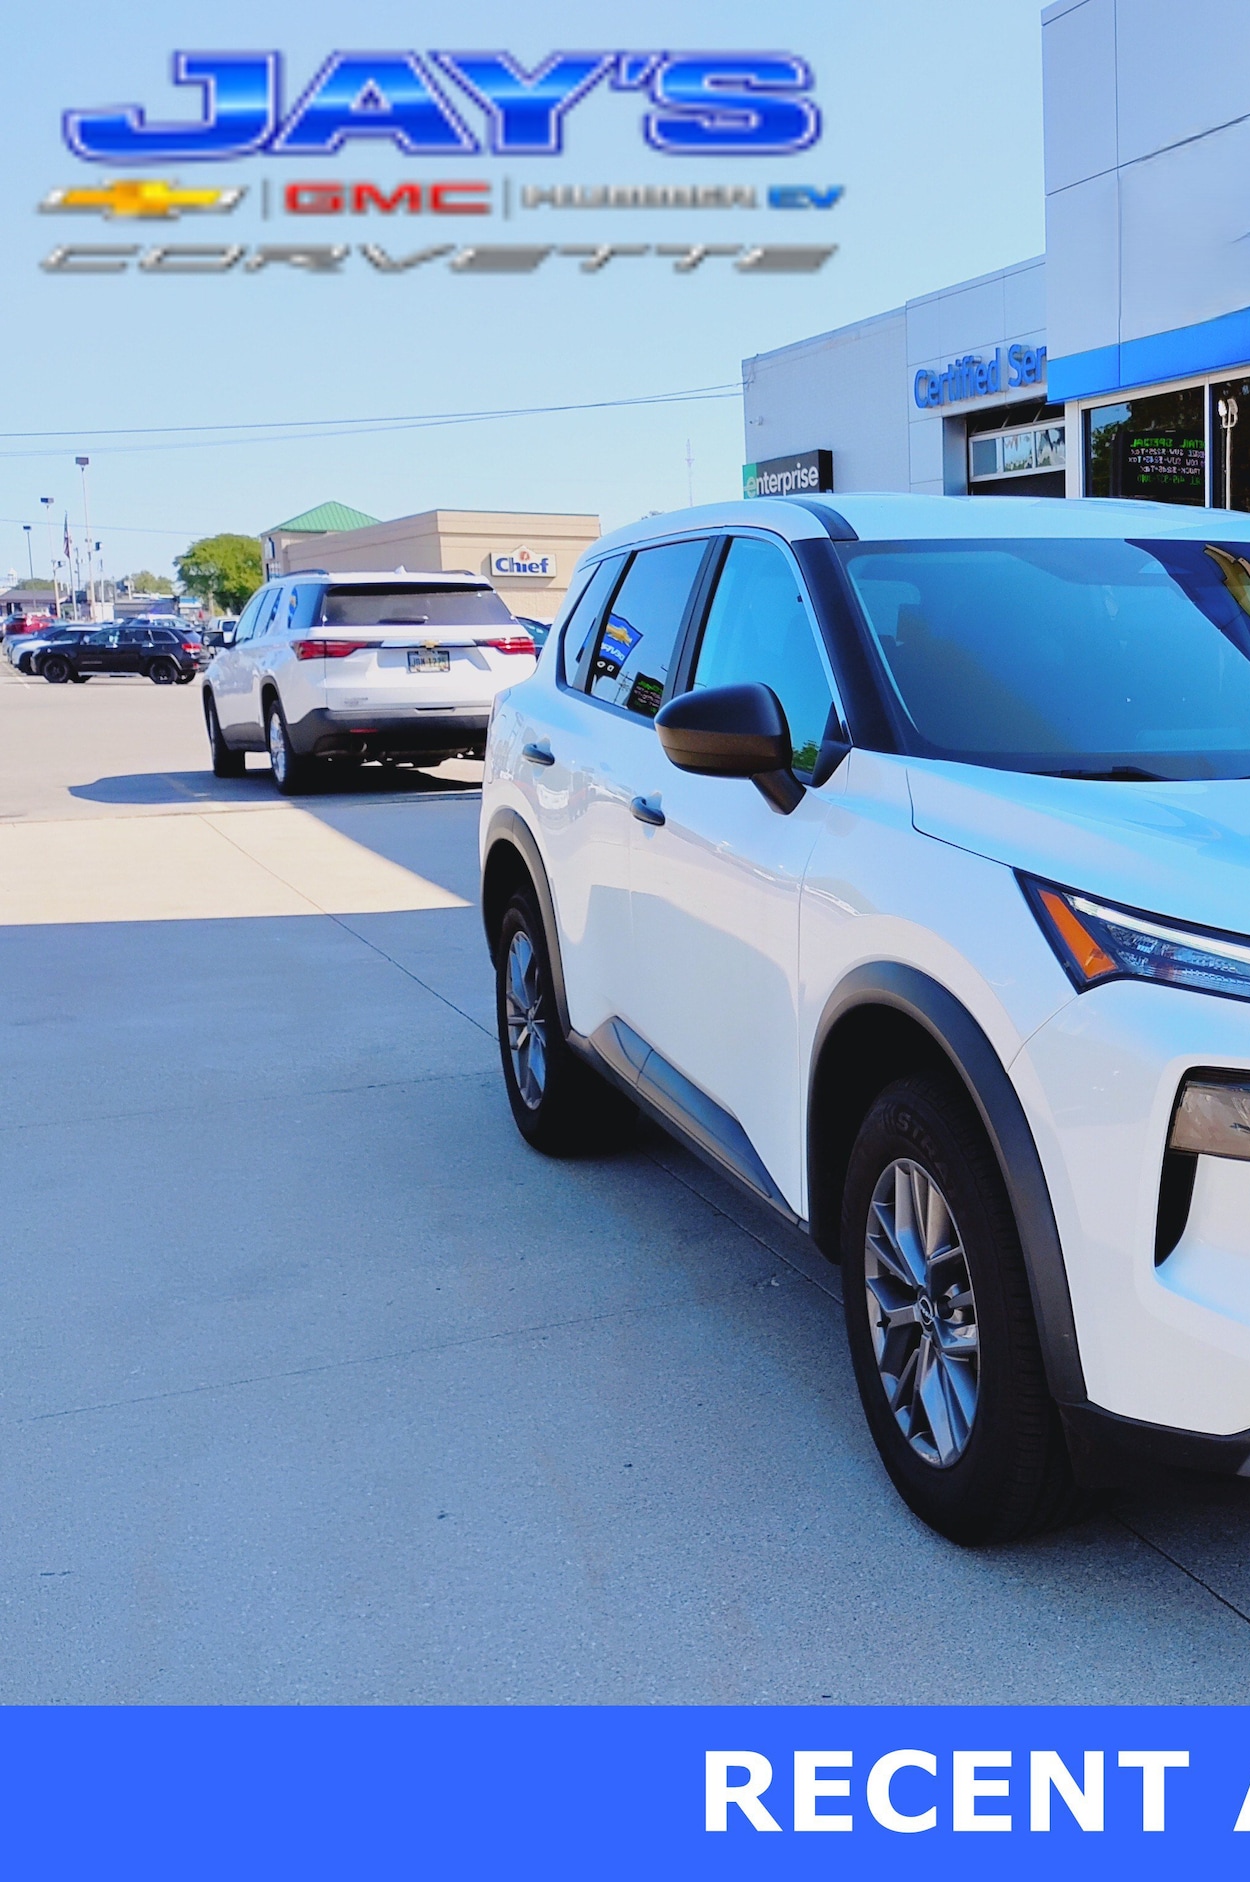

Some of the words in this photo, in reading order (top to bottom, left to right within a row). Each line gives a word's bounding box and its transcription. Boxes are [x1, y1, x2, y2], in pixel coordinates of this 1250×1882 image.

[914, 347, 1005, 409] Certified
[1008, 343, 1047, 388] Ser
[745, 462, 819, 498] enterprise
[495, 557, 549, 573] Chief
